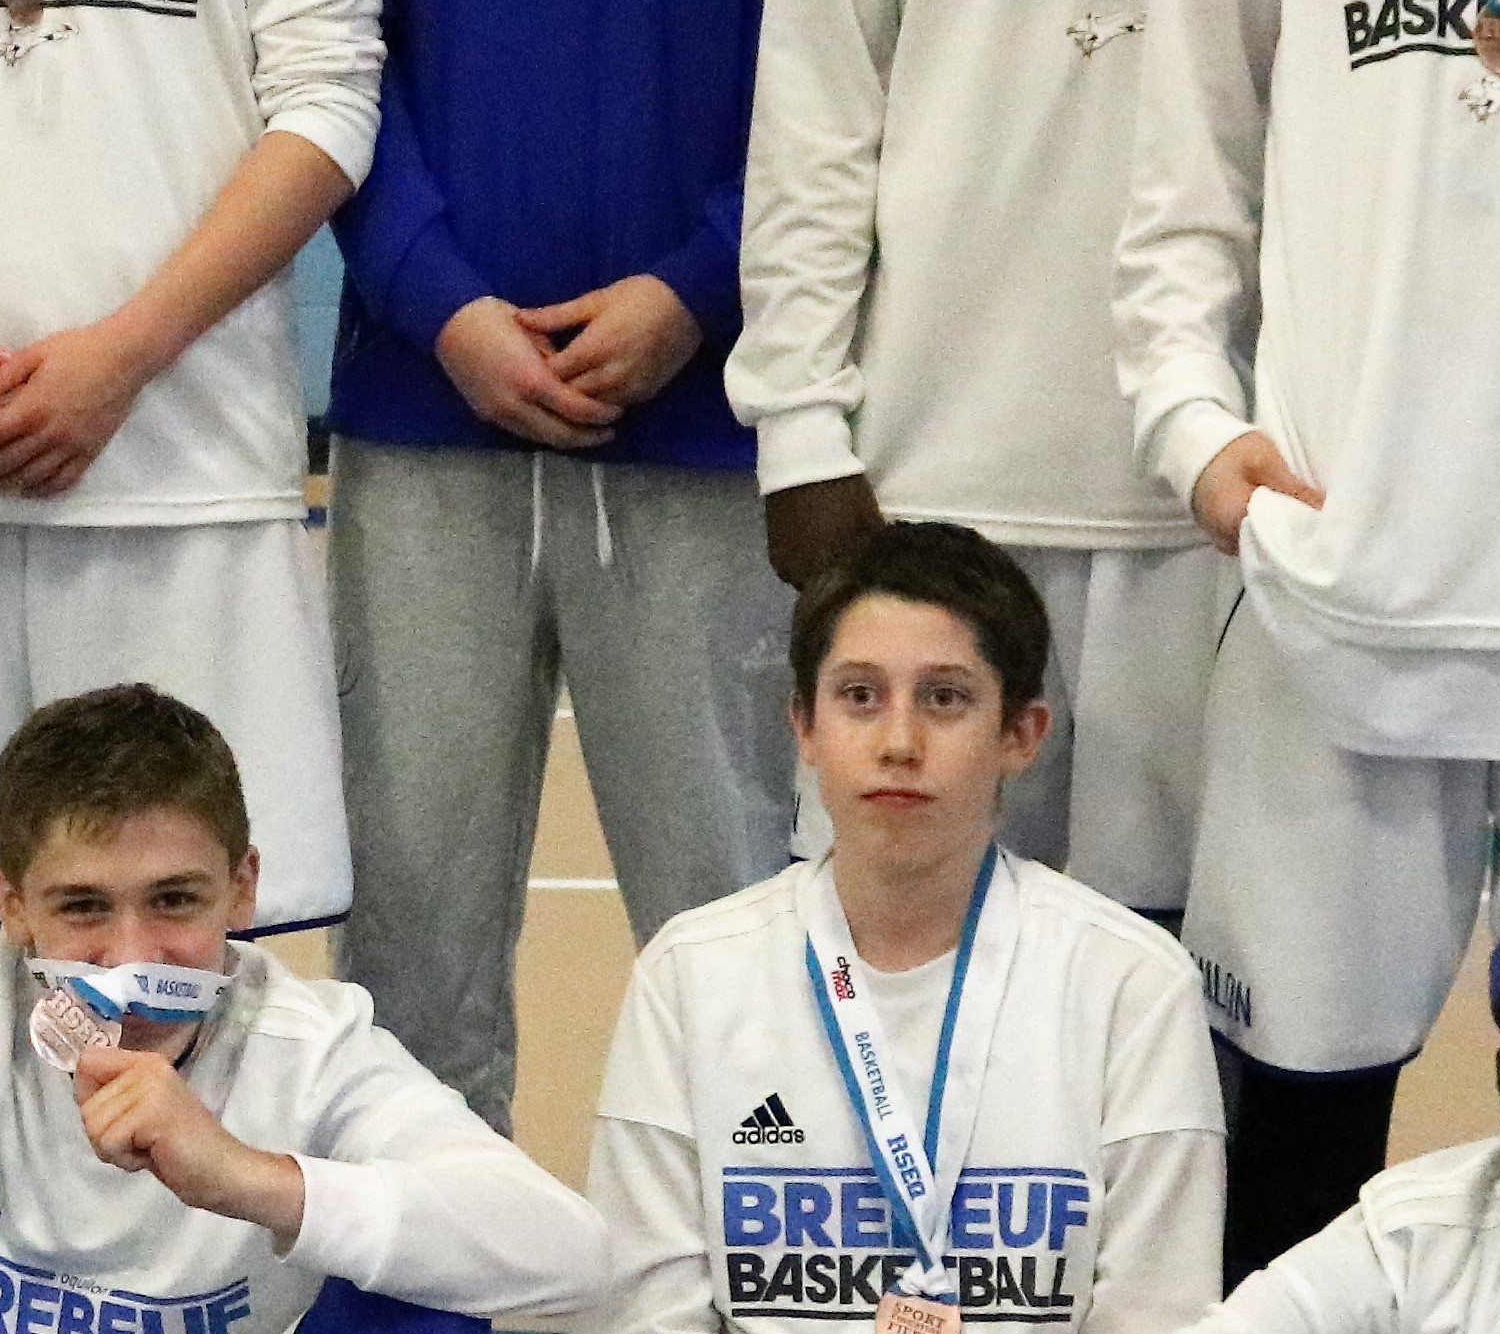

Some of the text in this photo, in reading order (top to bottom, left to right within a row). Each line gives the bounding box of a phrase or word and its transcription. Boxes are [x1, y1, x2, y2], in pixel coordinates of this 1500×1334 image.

[732, 1127, 805, 1145] adidas
[855, 1031, 892, 1121] BASKETBALL
[887, 1133, 926, 1201] RSEQ
